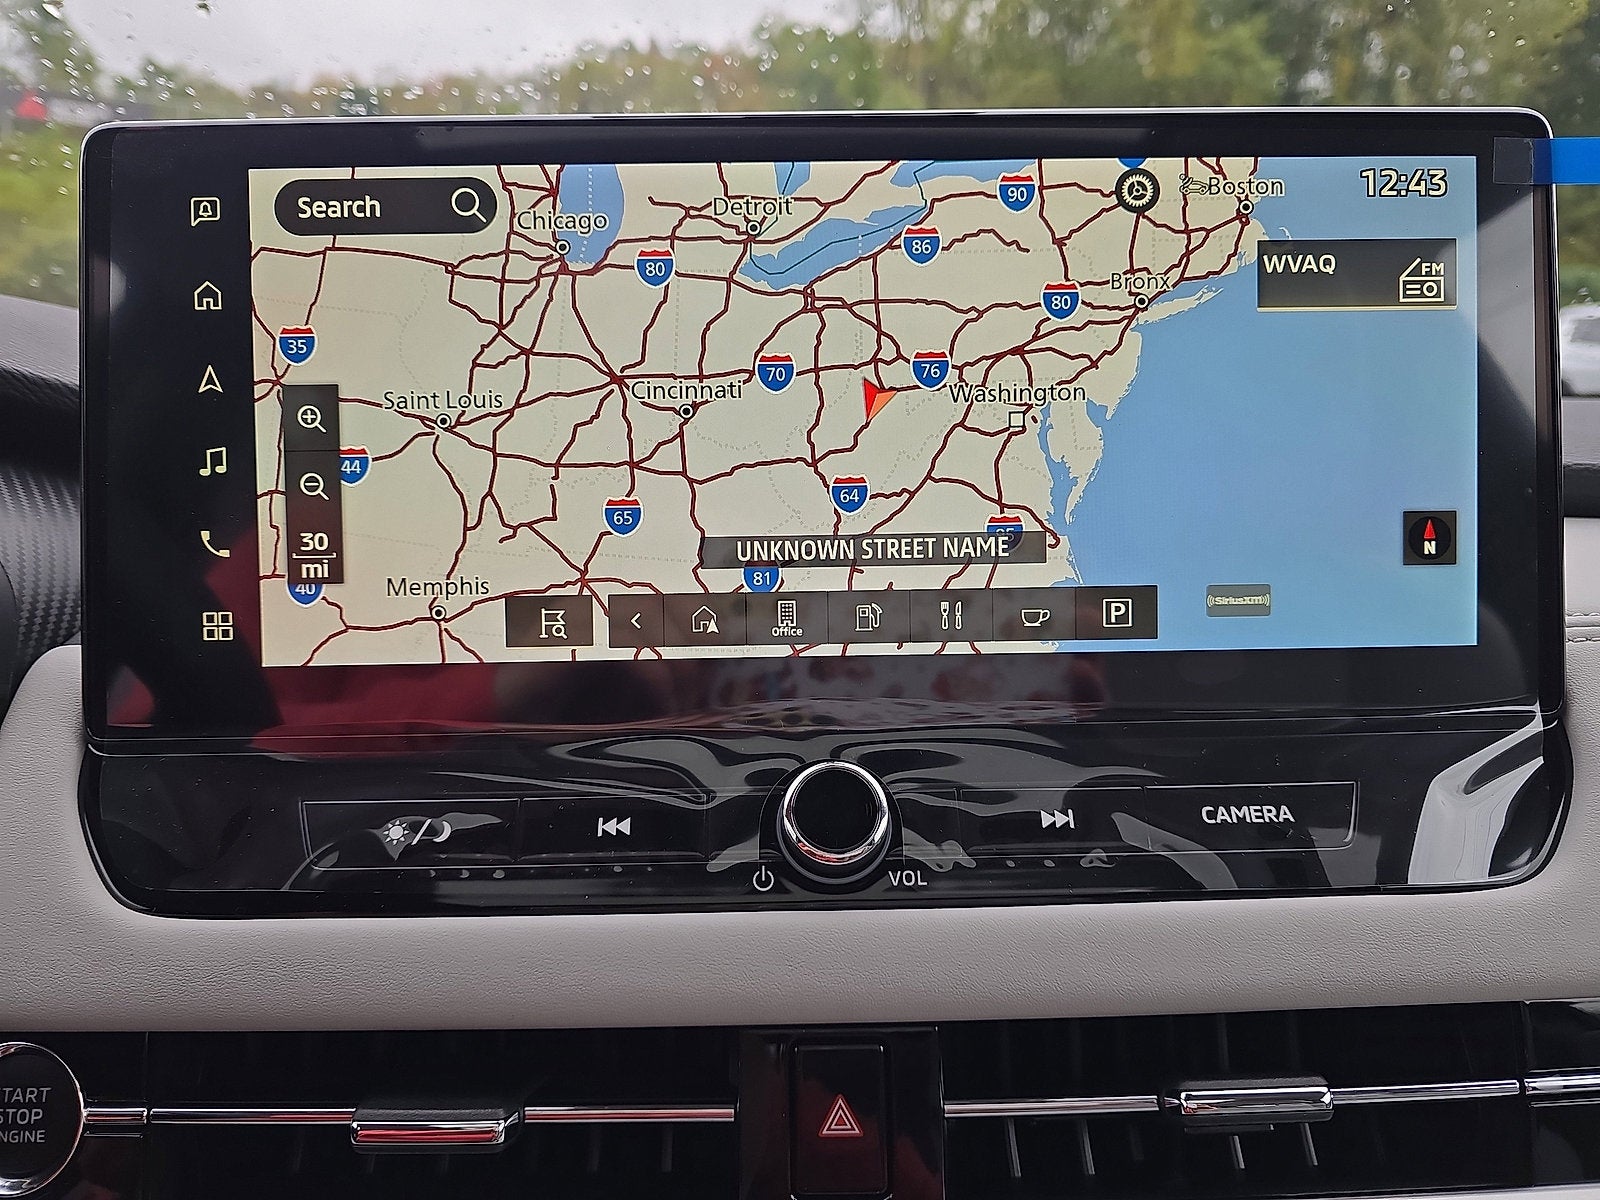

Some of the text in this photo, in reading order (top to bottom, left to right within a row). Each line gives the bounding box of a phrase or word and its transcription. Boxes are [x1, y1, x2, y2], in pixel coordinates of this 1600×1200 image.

[1208, 176, 1284, 196] Boston
[1360, 168, 1448, 198] 12:43
[1007, 187, 1028, 203] 90
[297, 196, 381, 219] Search
[713, 197, 793, 217] Detroit
[517, 211, 608, 234] Chicago
[911, 239, 932, 255] 86
[645, 261, 666, 277] 80
[1263, 254, 1336, 275] WVAQ
[1421, 262, 1445, 276] FM
[1110, 273, 1171, 291] Bronx
[1050, 294, 1072, 311] 80
[287, 338, 308, 355] 35
[766, 366, 787, 383] 70
[920, 362, 941, 379] 76
[631, 380, 743, 400] Cincinnati
[949, 384, 1086, 409] Washington
[383, 390, 503, 410] Saint Louis
[340, 459, 362, 475] 44
[839, 487, 861, 504] 64
[612, 509, 634, 526] 65
[299, 533, 329, 551] 30
[736, 535, 1011, 562] UNKNOWN STREET NAME
[1423, 541, 1436, 555] N
[301, 560, 330, 579] mi
[752, 570, 773, 587] 81
[386, 576, 491, 600] Memphis
[1110, 603, 1127, 624] P
[771, 625, 803, 637] Office
[1201, 804, 1295, 826] CAMERA
[888, 870, 928, 887] VOL
[0, 1087, 51, 1103] TART
[0, 1130, 46, 1143] NGINE
